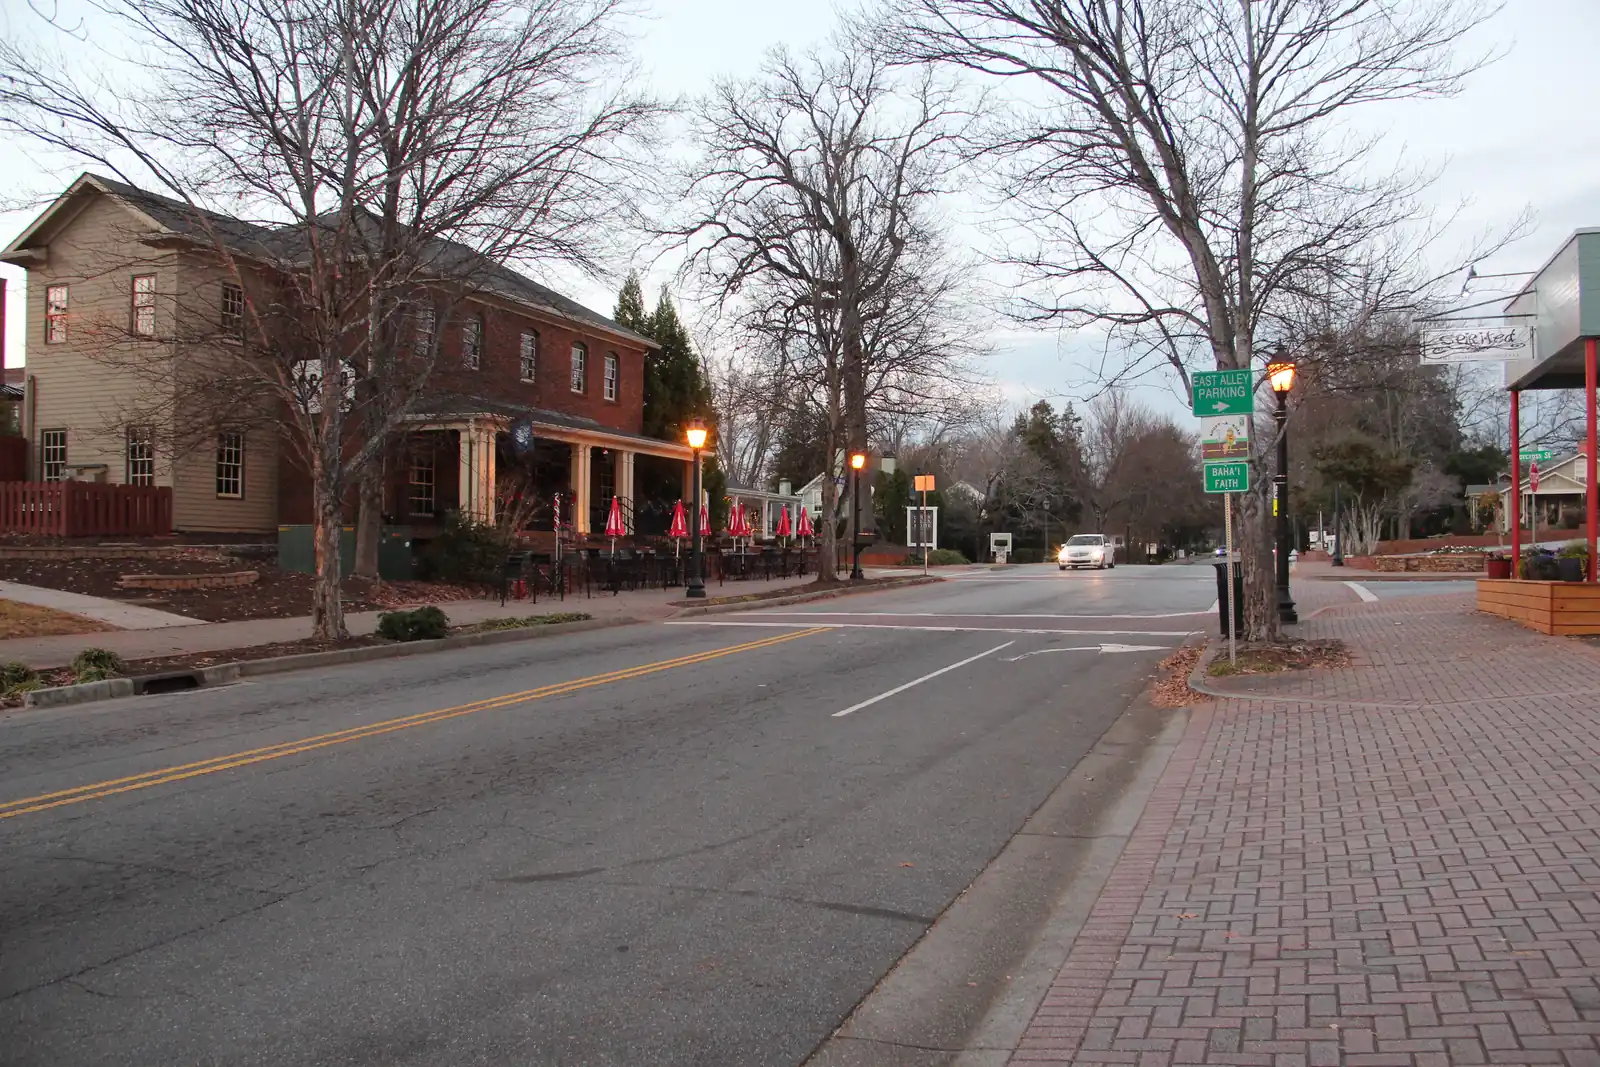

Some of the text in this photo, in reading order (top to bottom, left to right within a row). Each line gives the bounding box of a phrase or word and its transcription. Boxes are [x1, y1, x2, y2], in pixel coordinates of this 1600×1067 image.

[1193, 373, 1249, 387] EAST ALLEY
[1198, 386, 1246, 399] PARKING
[1212, 466, 1241, 476] BAHA'I
[1214, 478, 1239, 488] FAITH
